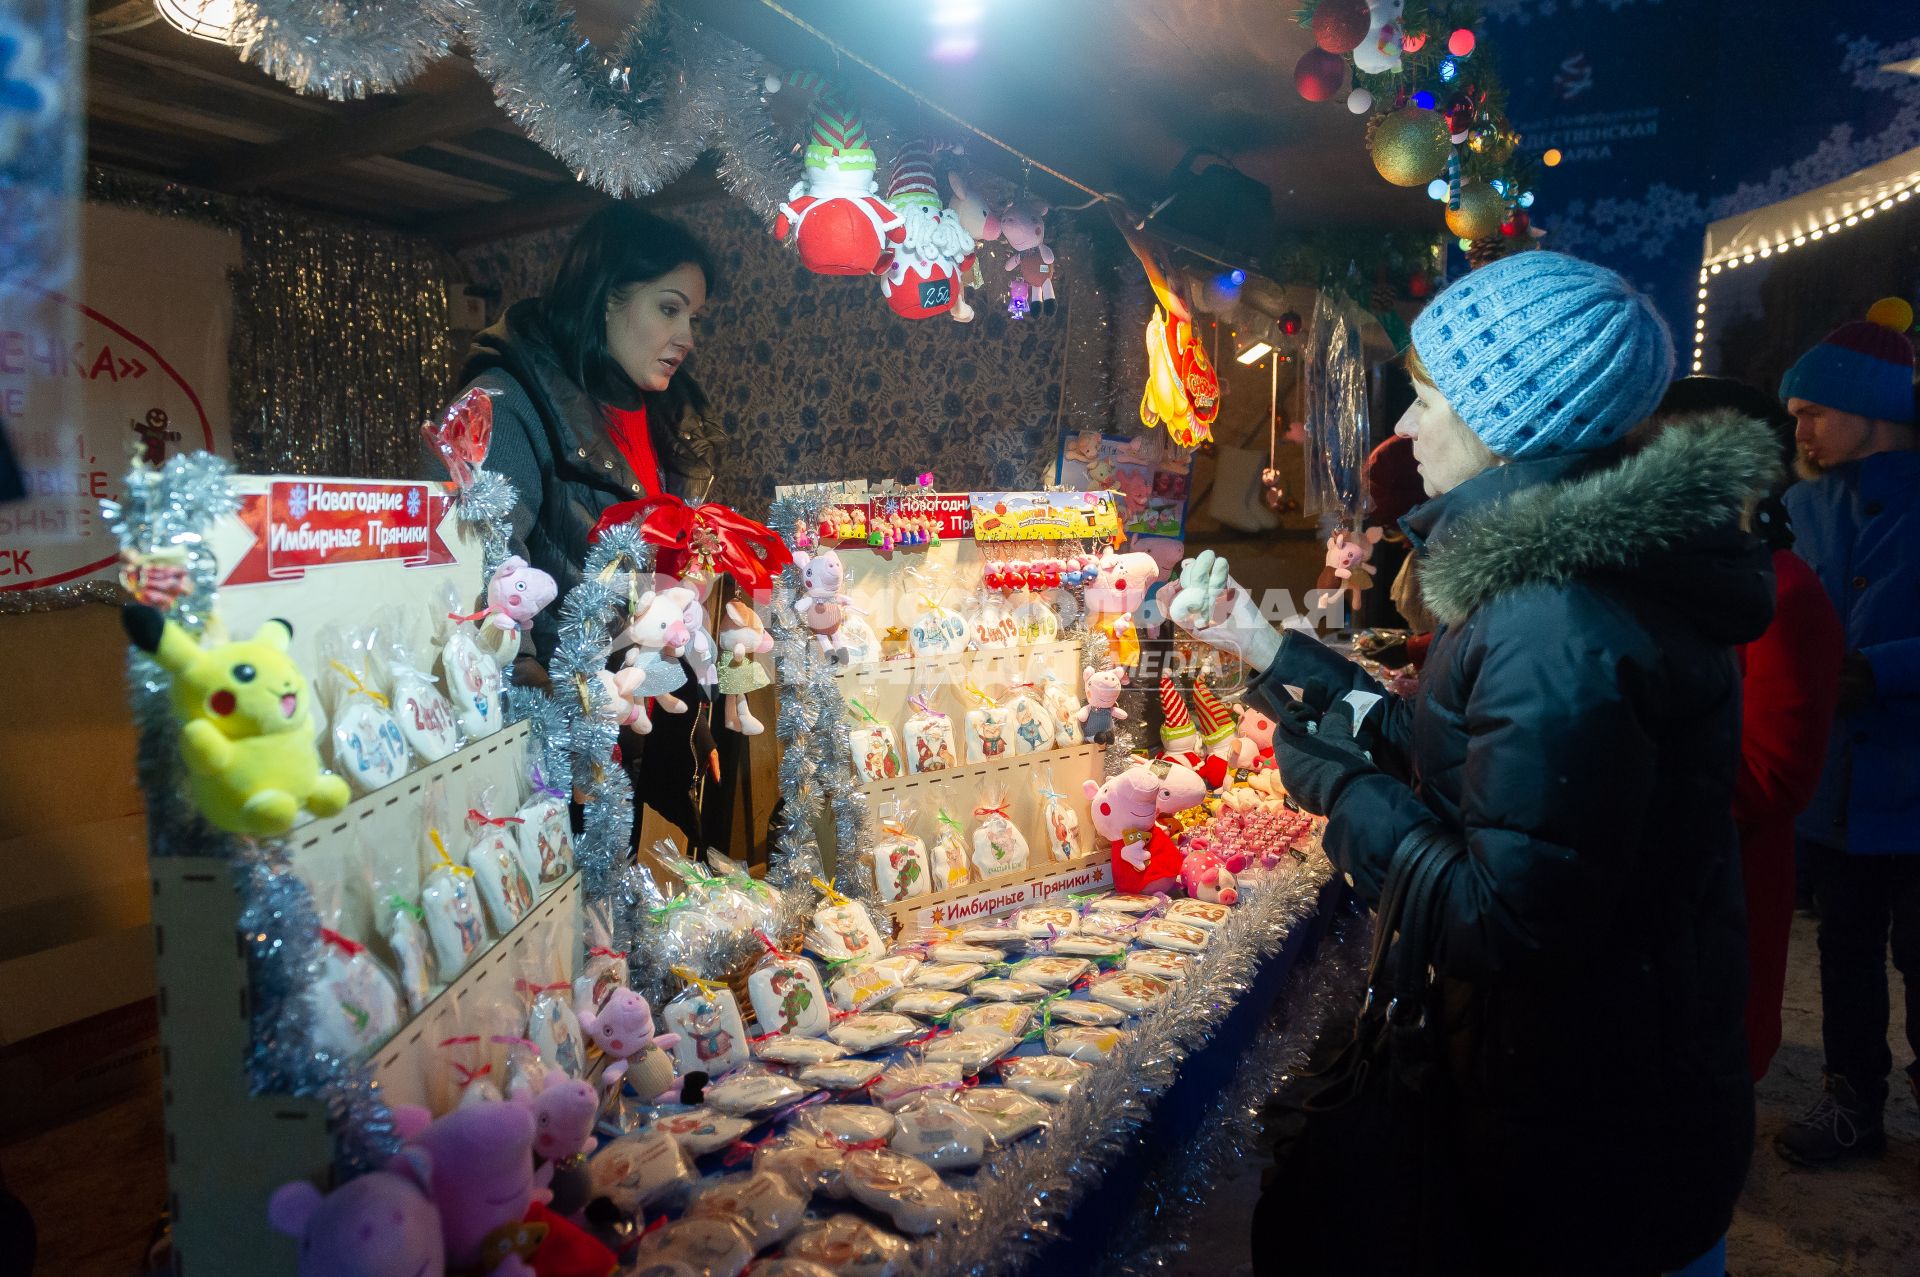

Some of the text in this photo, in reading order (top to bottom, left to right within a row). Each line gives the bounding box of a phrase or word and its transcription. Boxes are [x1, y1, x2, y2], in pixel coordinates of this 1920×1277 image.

[307, 483, 403, 513] Новогодние
[270, 519, 428, 557] Имбирные Пряники
[947, 873, 1090, 920] Имбирные Пряники
